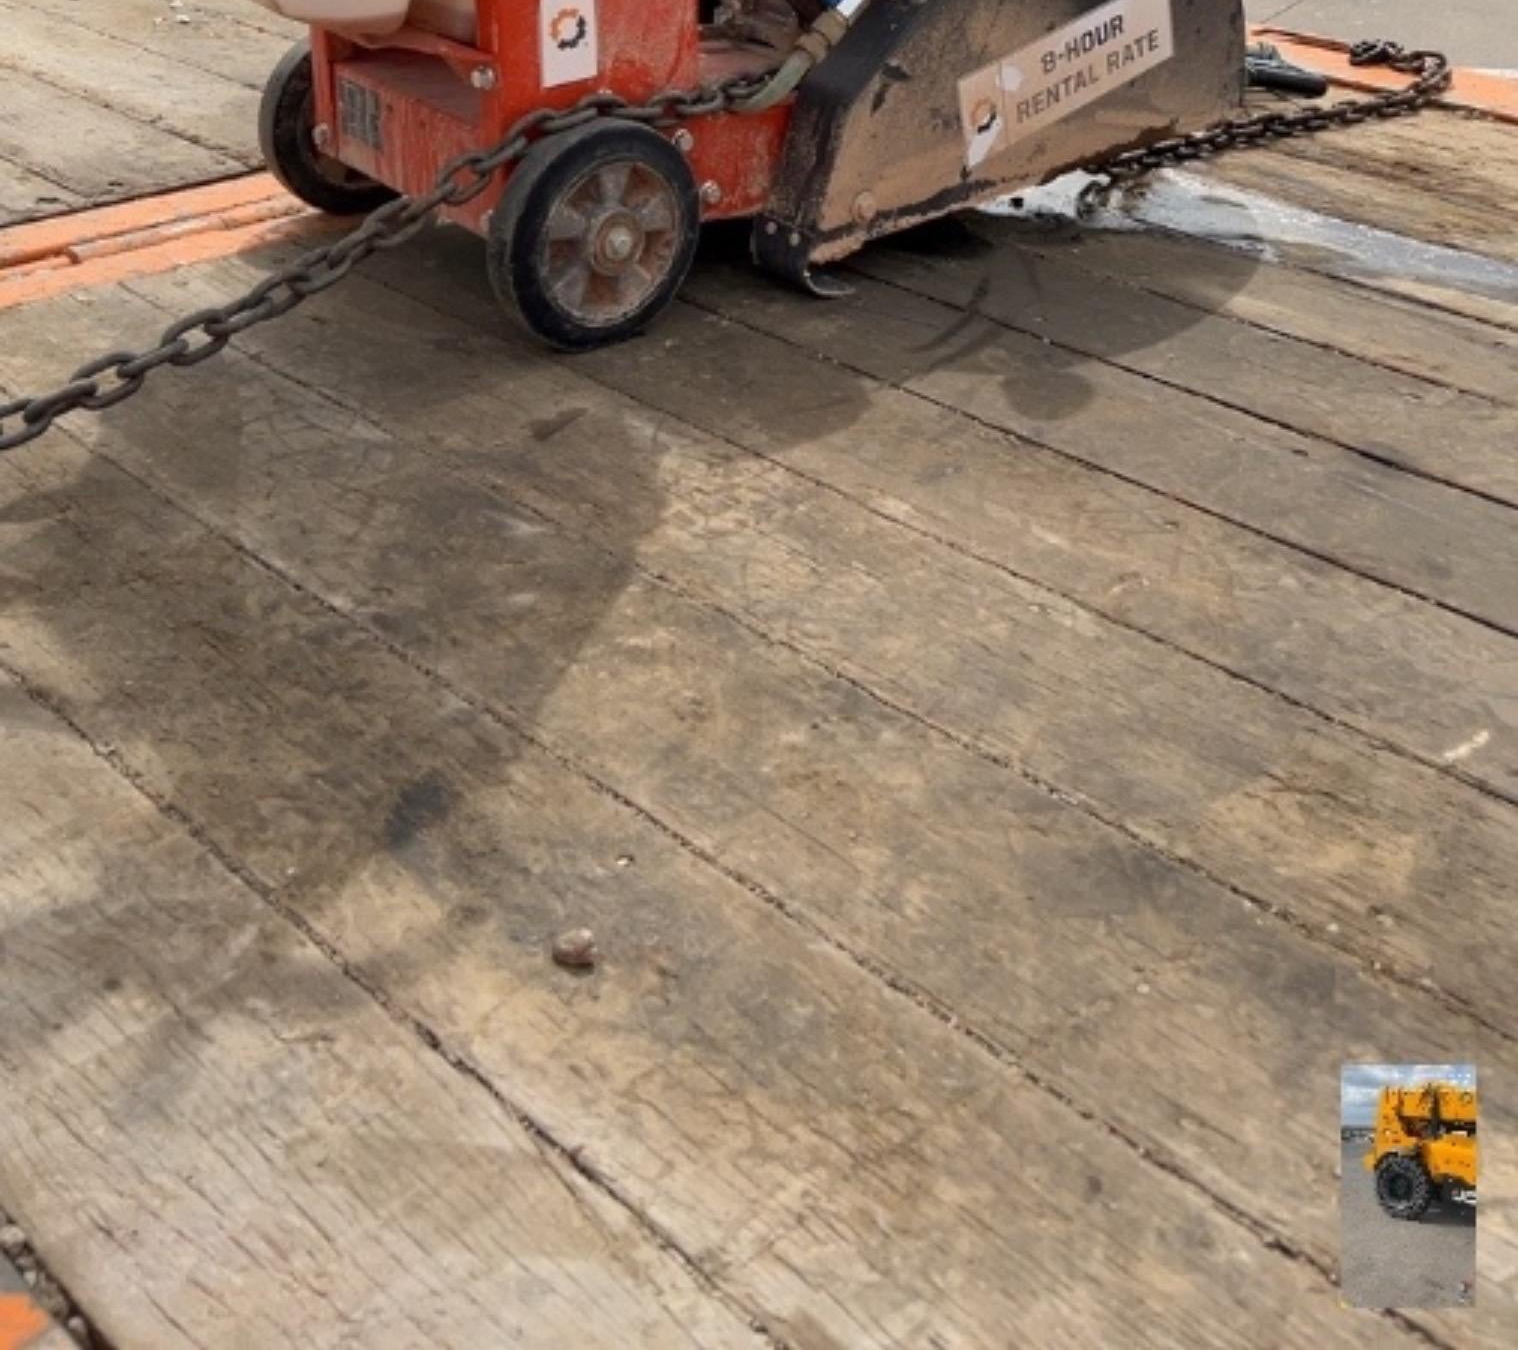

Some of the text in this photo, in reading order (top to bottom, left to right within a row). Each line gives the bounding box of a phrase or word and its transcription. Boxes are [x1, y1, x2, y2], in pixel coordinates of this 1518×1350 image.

[1016, 28, 1159, 123] RENTAL RATE
[1041, 14, 1124, 75] 8-HOUR
